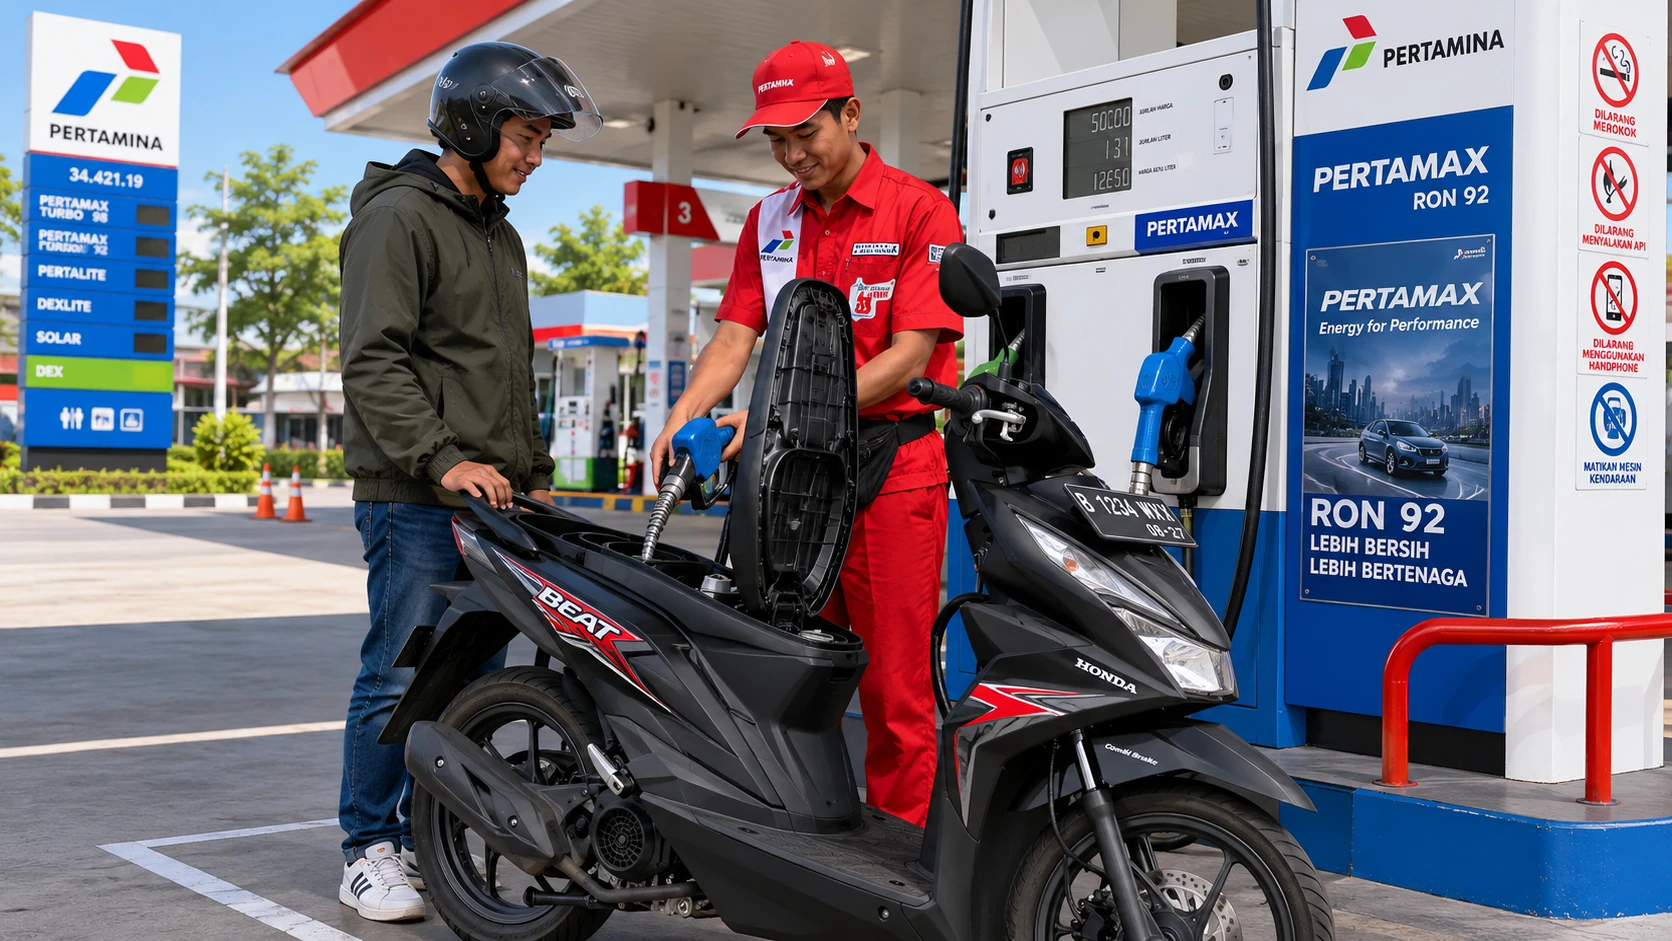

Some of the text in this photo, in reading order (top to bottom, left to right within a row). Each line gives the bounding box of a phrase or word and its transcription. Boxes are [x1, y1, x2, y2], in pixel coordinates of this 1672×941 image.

[1383, 29, 1505, 68] PERTAMINA
[1595, 108, 1636, 126] DILARANG
[49, 123, 163, 151] PERTAMINA
[1593, 120, 1637, 138] MEROKOK
[69, 167, 144, 189] 34.421.19
[1312, 145, 1490, 193] PERTAMAX
[39, 195, 109, 212] PERTAMAX
[1413, 185, 1489, 210] RON 92
[39, 206, 84, 220] TURBO
[677, 201, 692, 225] 3
[1147, 211, 1239, 238] PERTAMAX
[1594, 223, 1635, 238] DILARANG
[38, 229, 109, 245] PERTAMAX
[1582, 234, 1646, 251] MENYALAKAN API
[38, 265, 107, 281] PERTALITE
[37, 297, 92, 313] DEXLITE
[1320, 281, 1484, 312] PERTAMAX
[1319, 317, 1480, 336] Energy for Performance
[36, 331, 82, 345] SOLAR
[1582, 349, 1645, 361] MENGGUNAKAN
[35, 364, 64, 378] DEX
[1589, 361, 1639, 373] HANDPHONE
[1583, 461, 1618, 472] MATIKAN
[1589, 474, 1636, 484] KENDARAAN
[1075, 492, 1175, 523] B 1234 WXX
[1311, 498, 1445, 534] RON 92
[1146, 523, 1185, 540] 08-27
[1310, 534, 1430, 560] LEBIH BERSIH
[1309, 557, 1468, 588] LEBIH BERTENAGA
[537, 585, 621, 640] BEAT
[1074, 657, 1138, 695] HONDA
